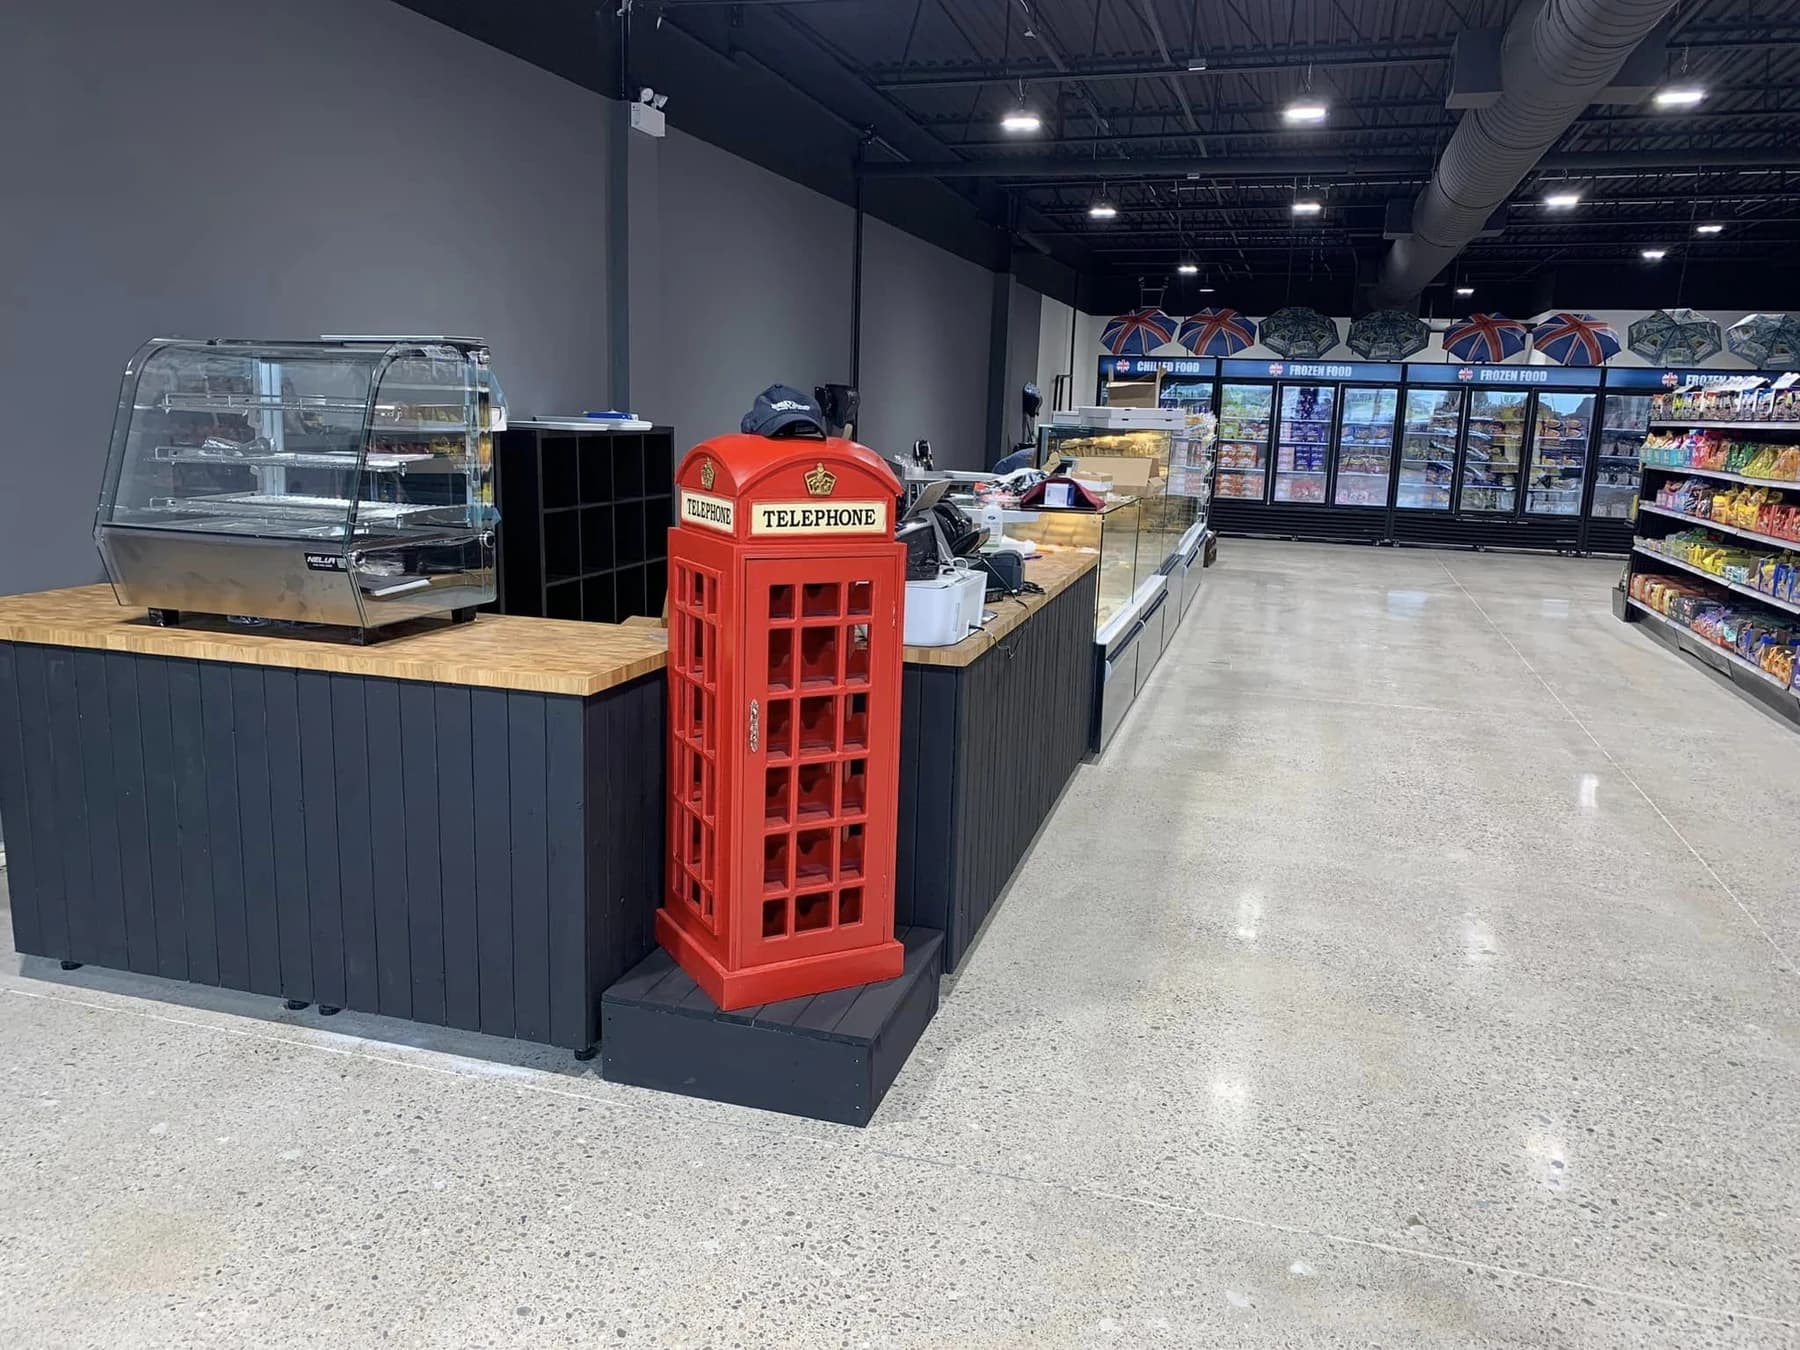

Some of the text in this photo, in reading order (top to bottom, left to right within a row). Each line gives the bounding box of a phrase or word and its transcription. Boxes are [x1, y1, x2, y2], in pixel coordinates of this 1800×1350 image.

[1175, 361, 1200, 373] FOOD
[1289, 364, 1352, 378] FROZEN FOOD
[1480, 369, 1548, 382] FROZEN FOOD
[687, 498, 731, 525] TELEPHONE
[762, 509, 876, 528] TELEPHONE
